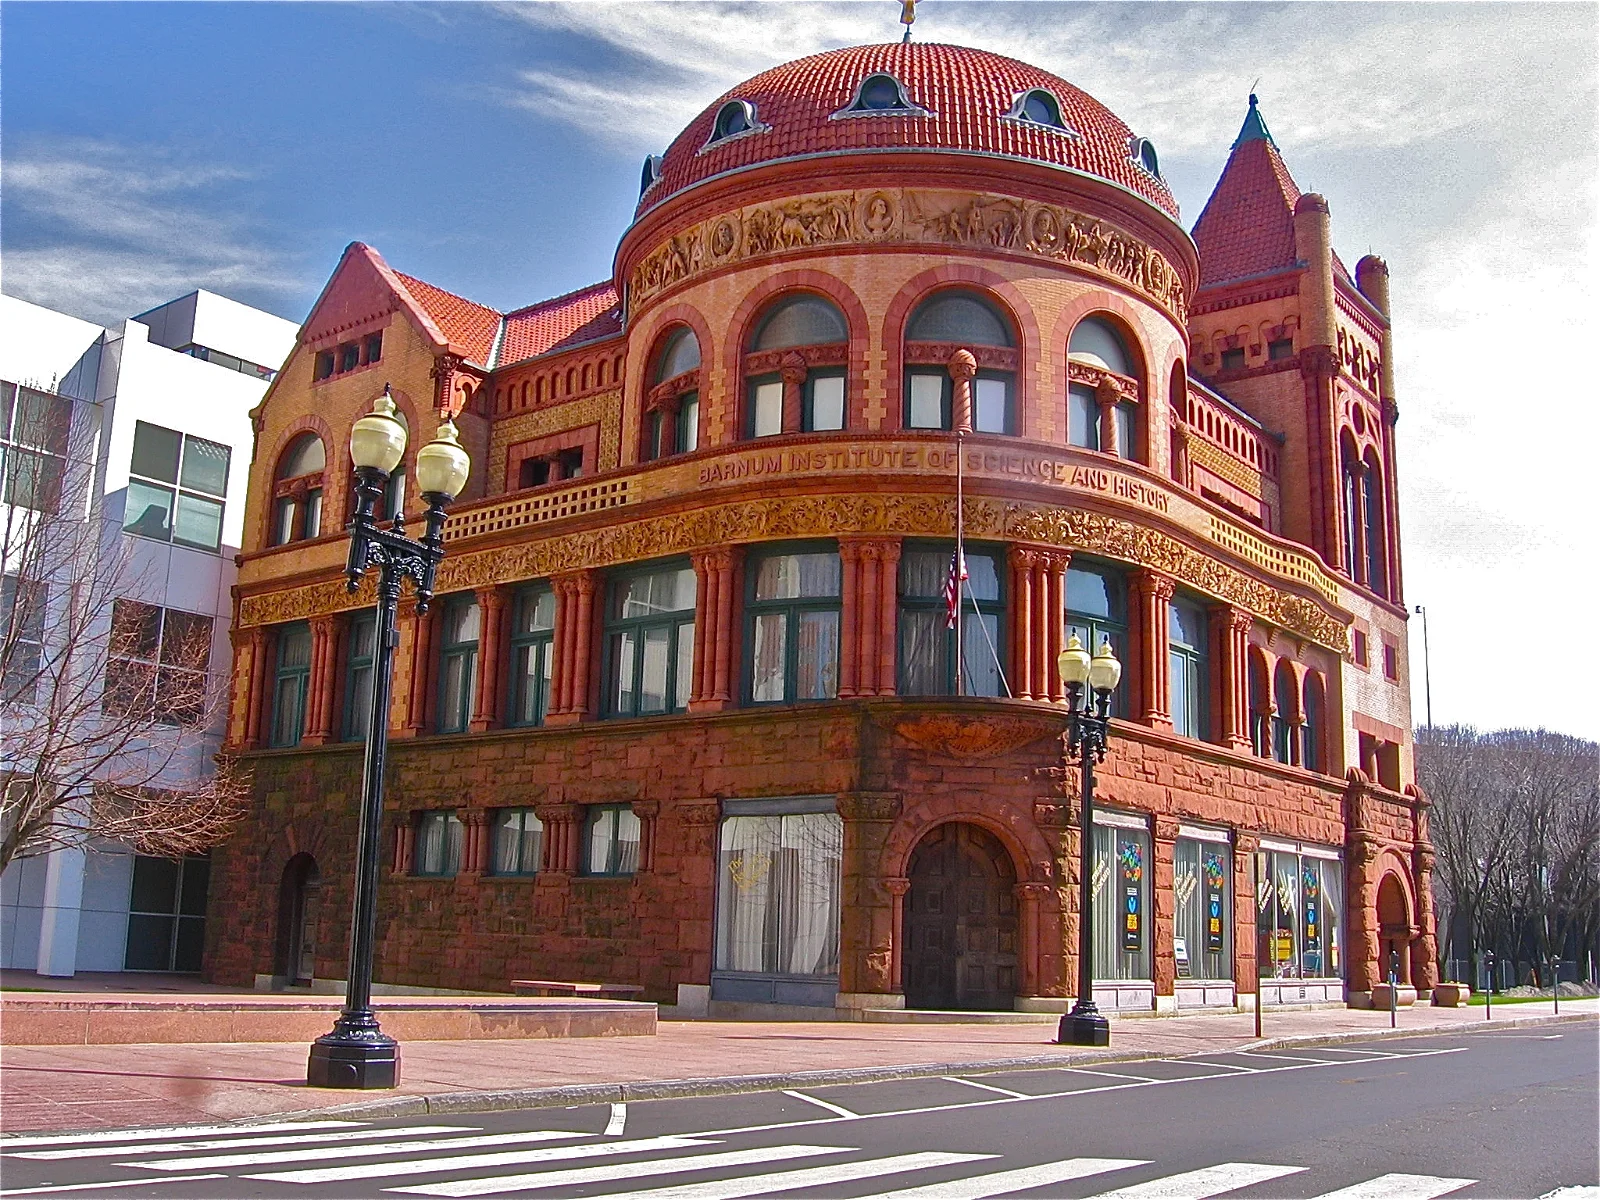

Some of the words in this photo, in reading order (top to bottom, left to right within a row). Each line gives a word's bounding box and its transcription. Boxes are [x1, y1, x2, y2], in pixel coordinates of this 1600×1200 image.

[700, 455, 783, 484] BARNUM
[788, 449, 919, 470] INSTITUTE
[928, 450, 958, 468] OF
[967, 452, 1065, 481] SCIENCE
[1072, 466, 1109, 491] AND
[1113, 474, 1170, 513] HISTORY
